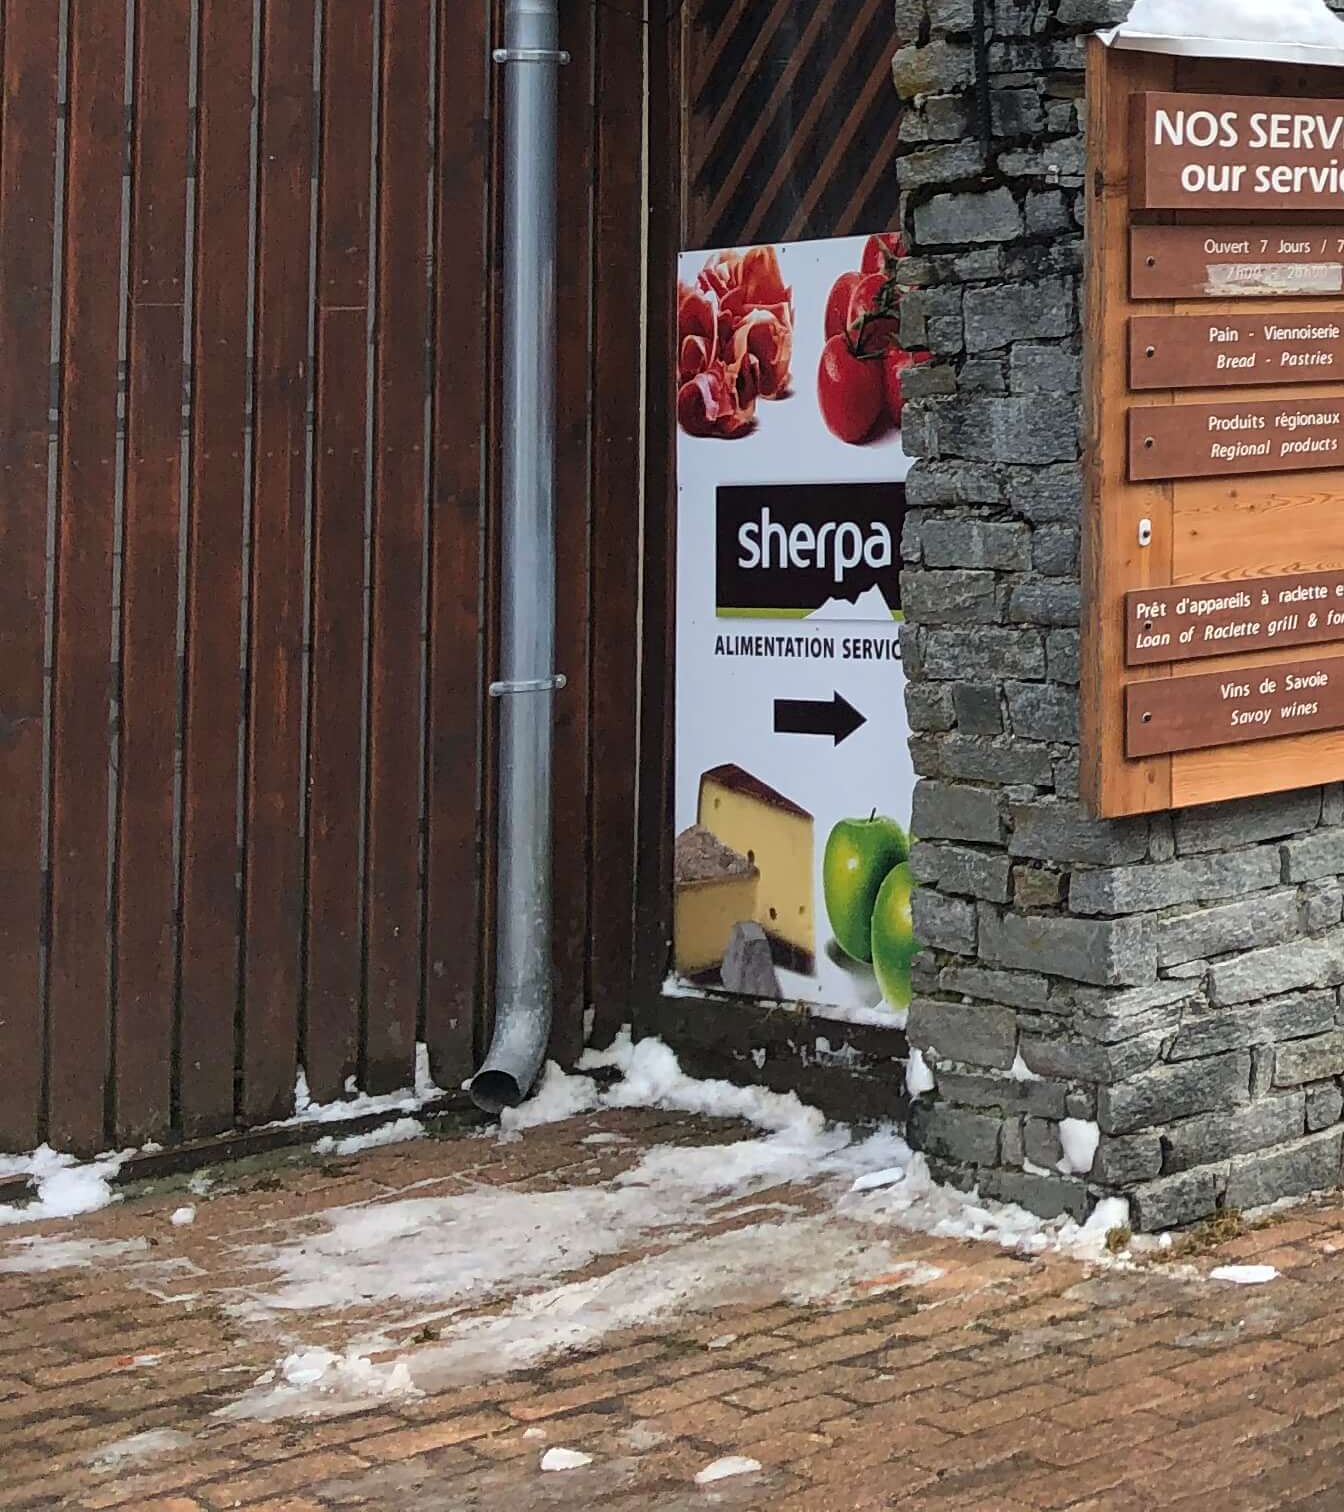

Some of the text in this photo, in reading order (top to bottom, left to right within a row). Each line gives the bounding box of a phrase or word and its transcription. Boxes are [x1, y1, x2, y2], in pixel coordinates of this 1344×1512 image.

[1154, 109, 1238, 147] NOS
[1181, 164, 1247, 192] our
[1204, 239, 1344, 254] Ouvert 7 Jours / 7
[1209, 326, 1238, 342] Pain
[1264, 324, 1340, 341] Viennoiserie
[1217, 352, 1256, 369] Bread
[1280, 351, 1333, 367] Pastries
[1208, 412, 1340, 431] Produits régionaux
[1211, 437, 1337, 461] Regional products
[738, 507, 892, 582] sherpa
[1136, 600, 1167, 619] Prêt
[1175, 592, 1251, 619] d'appareils
[1260, 590, 1269, 605] à
[1279, 583, 1328, 604] raclette
[1136, 631, 1170, 649] Loan
[1179, 626, 1195, 644] of
[1204, 621, 1260, 642] Raclette
[1268, 614, 1298, 635] grill
[1308, 613, 1319, 628] &
[715, 635, 834, 658] ALIMENTATION
[1220, 671, 1329, 700] Vins de Savoie
[1231, 700, 1318, 726] Savoy wines
